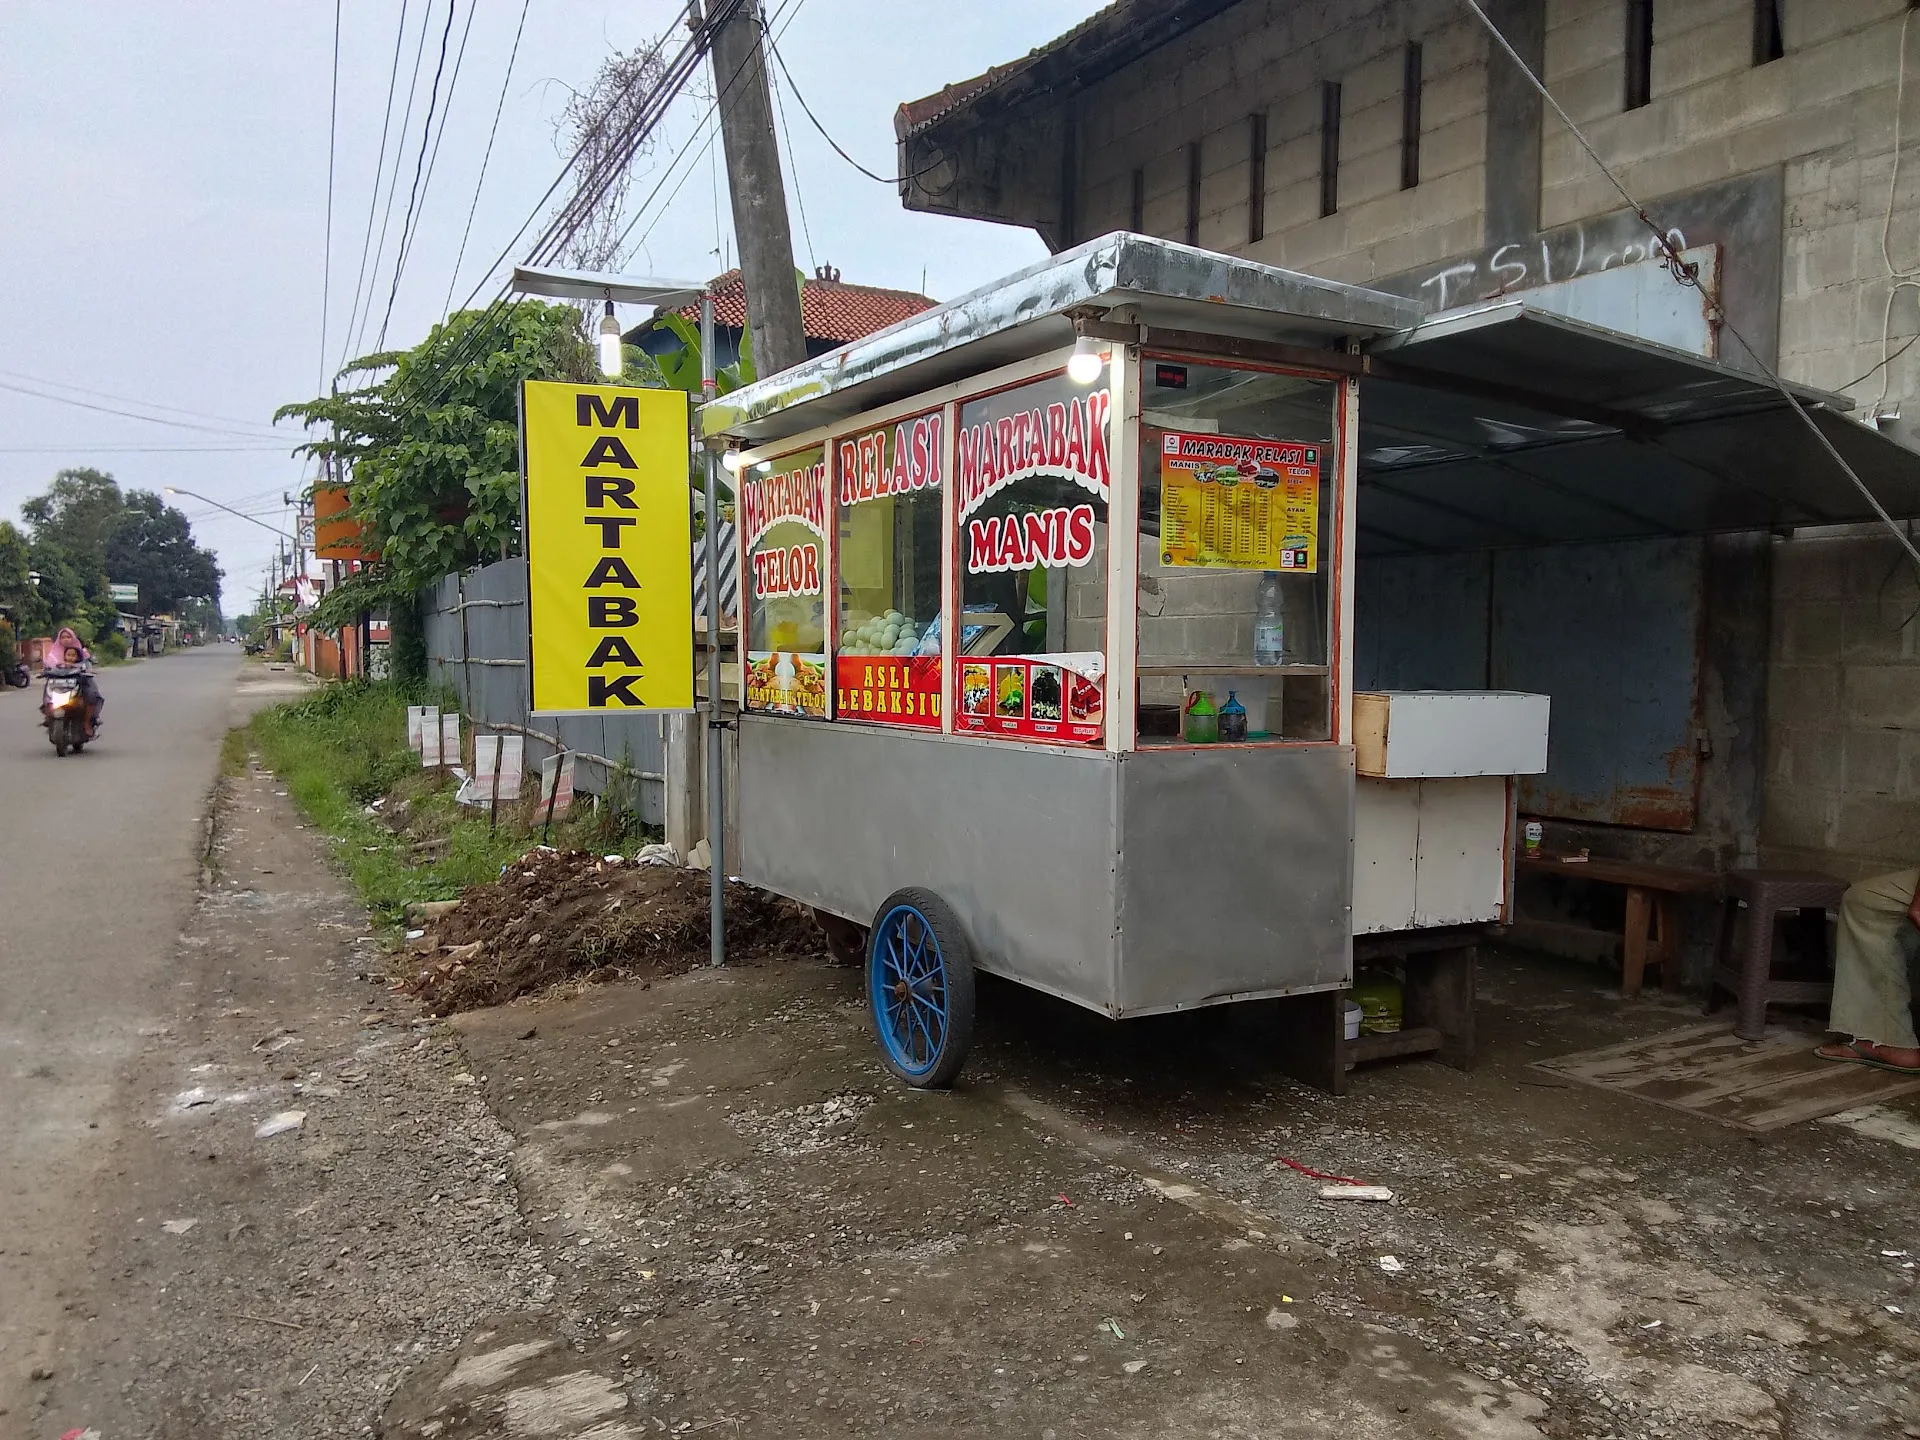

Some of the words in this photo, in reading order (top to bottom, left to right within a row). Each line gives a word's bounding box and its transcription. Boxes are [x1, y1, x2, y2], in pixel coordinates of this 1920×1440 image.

[841, 414, 942, 505] RELASI
[959, 390, 1110, 522] MARTABAK
[1169, 461, 1200, 469] MANIS
[1183, 440, 1251, 460] MARABAK
[1255, 446, 1302, 464] RELASI
[1288, 467, 1311, 476] TELOR
[745, 464, 825, 552] MARTABAK
[576, 394, 646, 708] MARTABAK
[970, 505, 1094, 573] MANIS
[754, 545, 820, 598] TELOR
[748, 687, 793, 704] MARTABAK
[863, 665, 910, 689] ASLI
[838, 688, 941, 717] LEBAKSIU
